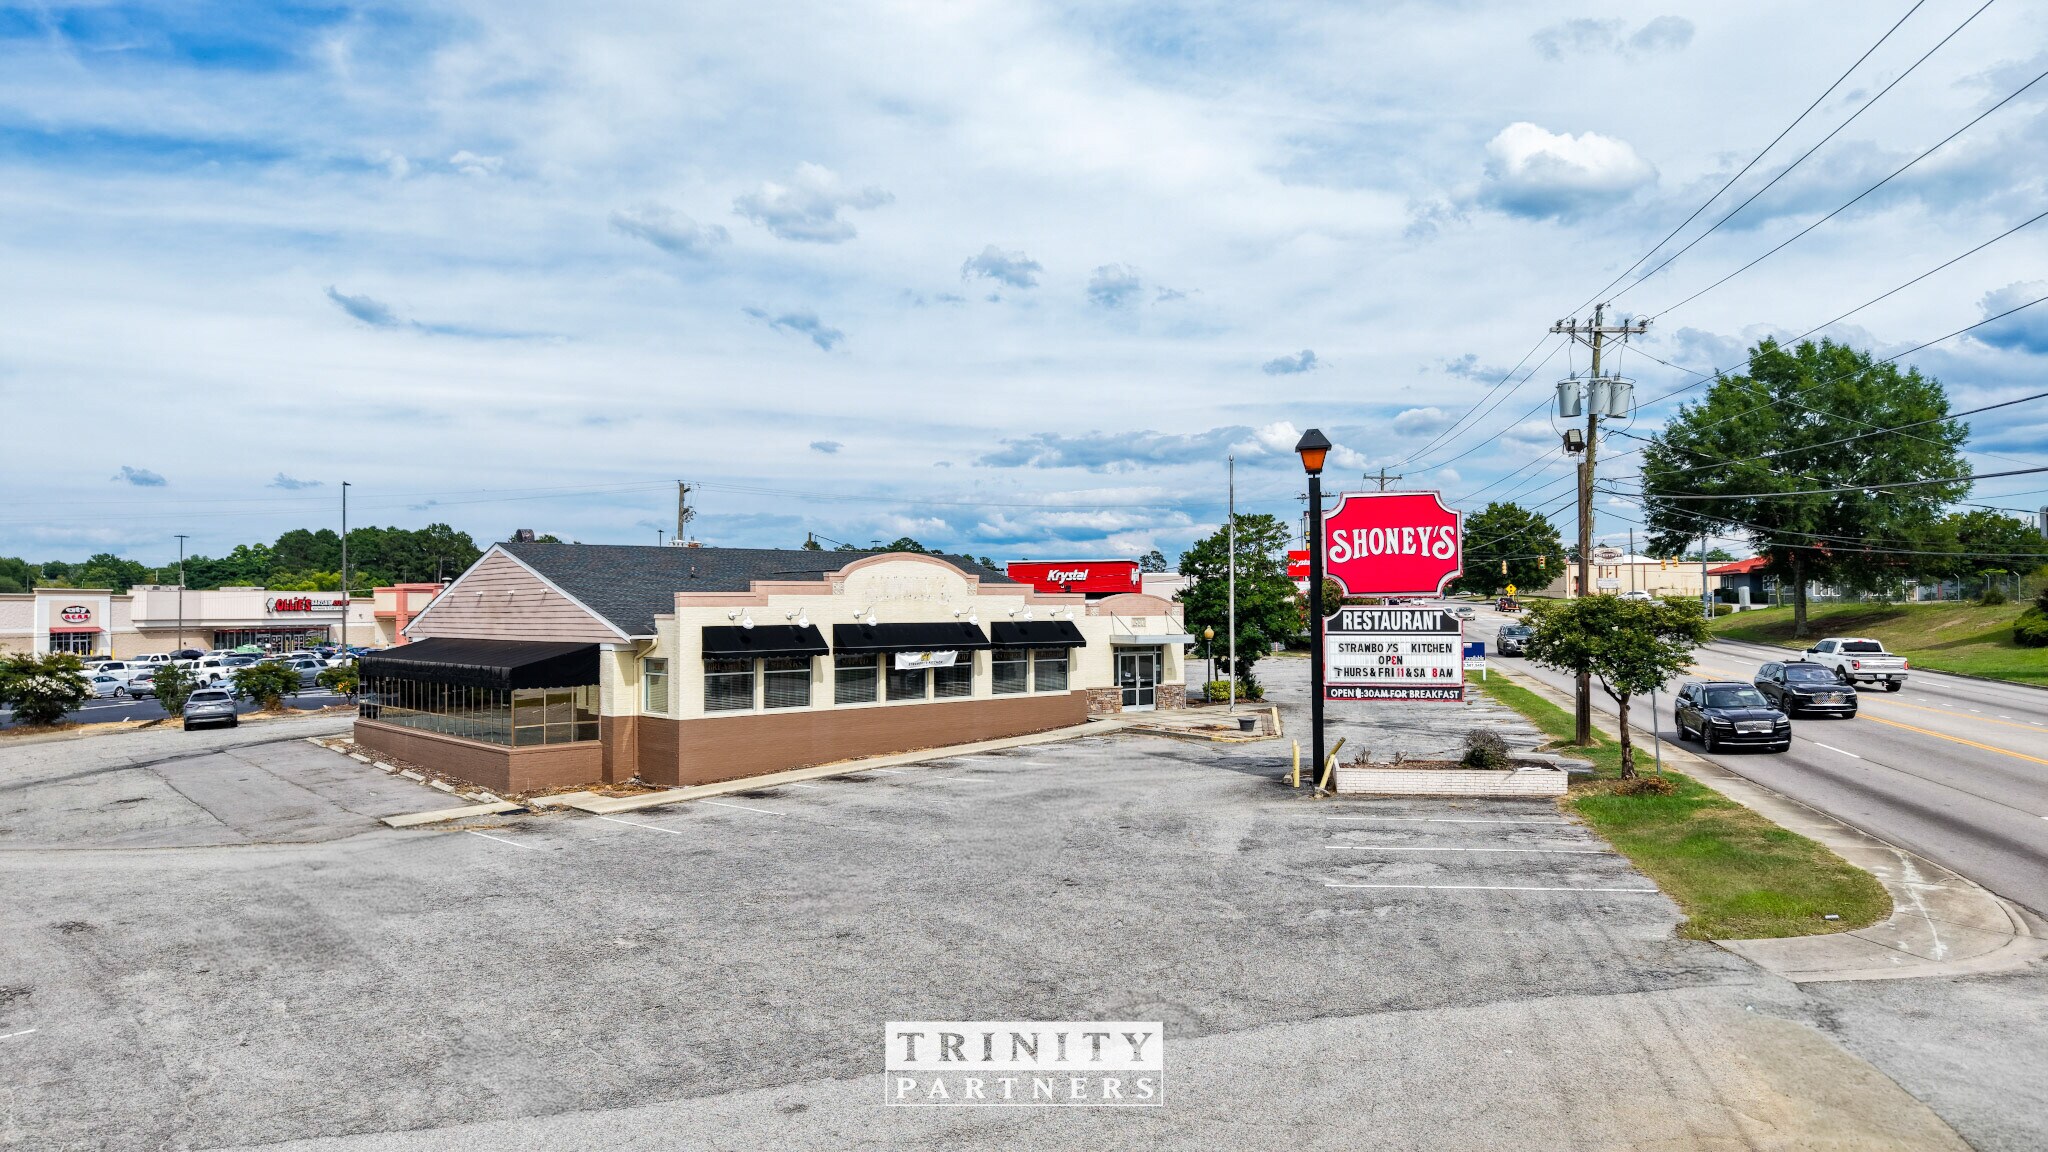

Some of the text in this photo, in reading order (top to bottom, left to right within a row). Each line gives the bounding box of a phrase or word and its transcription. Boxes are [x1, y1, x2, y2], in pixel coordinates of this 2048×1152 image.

[1329, 525, 1456, 563] SHONEY'S
[1047, 569, 1089, 585] Krystal
[1342, 611, 1443, 631] RESTAURANT
[1411, 643, 1453, 653] KITCHEN
[1378, 655, 1403, 665] OPEN
[1330, 688, 1355, 698] OPEN
[1390, 690, 1408, 699] FOR
[1409, 690, 1459, 699] BREAKFAST
